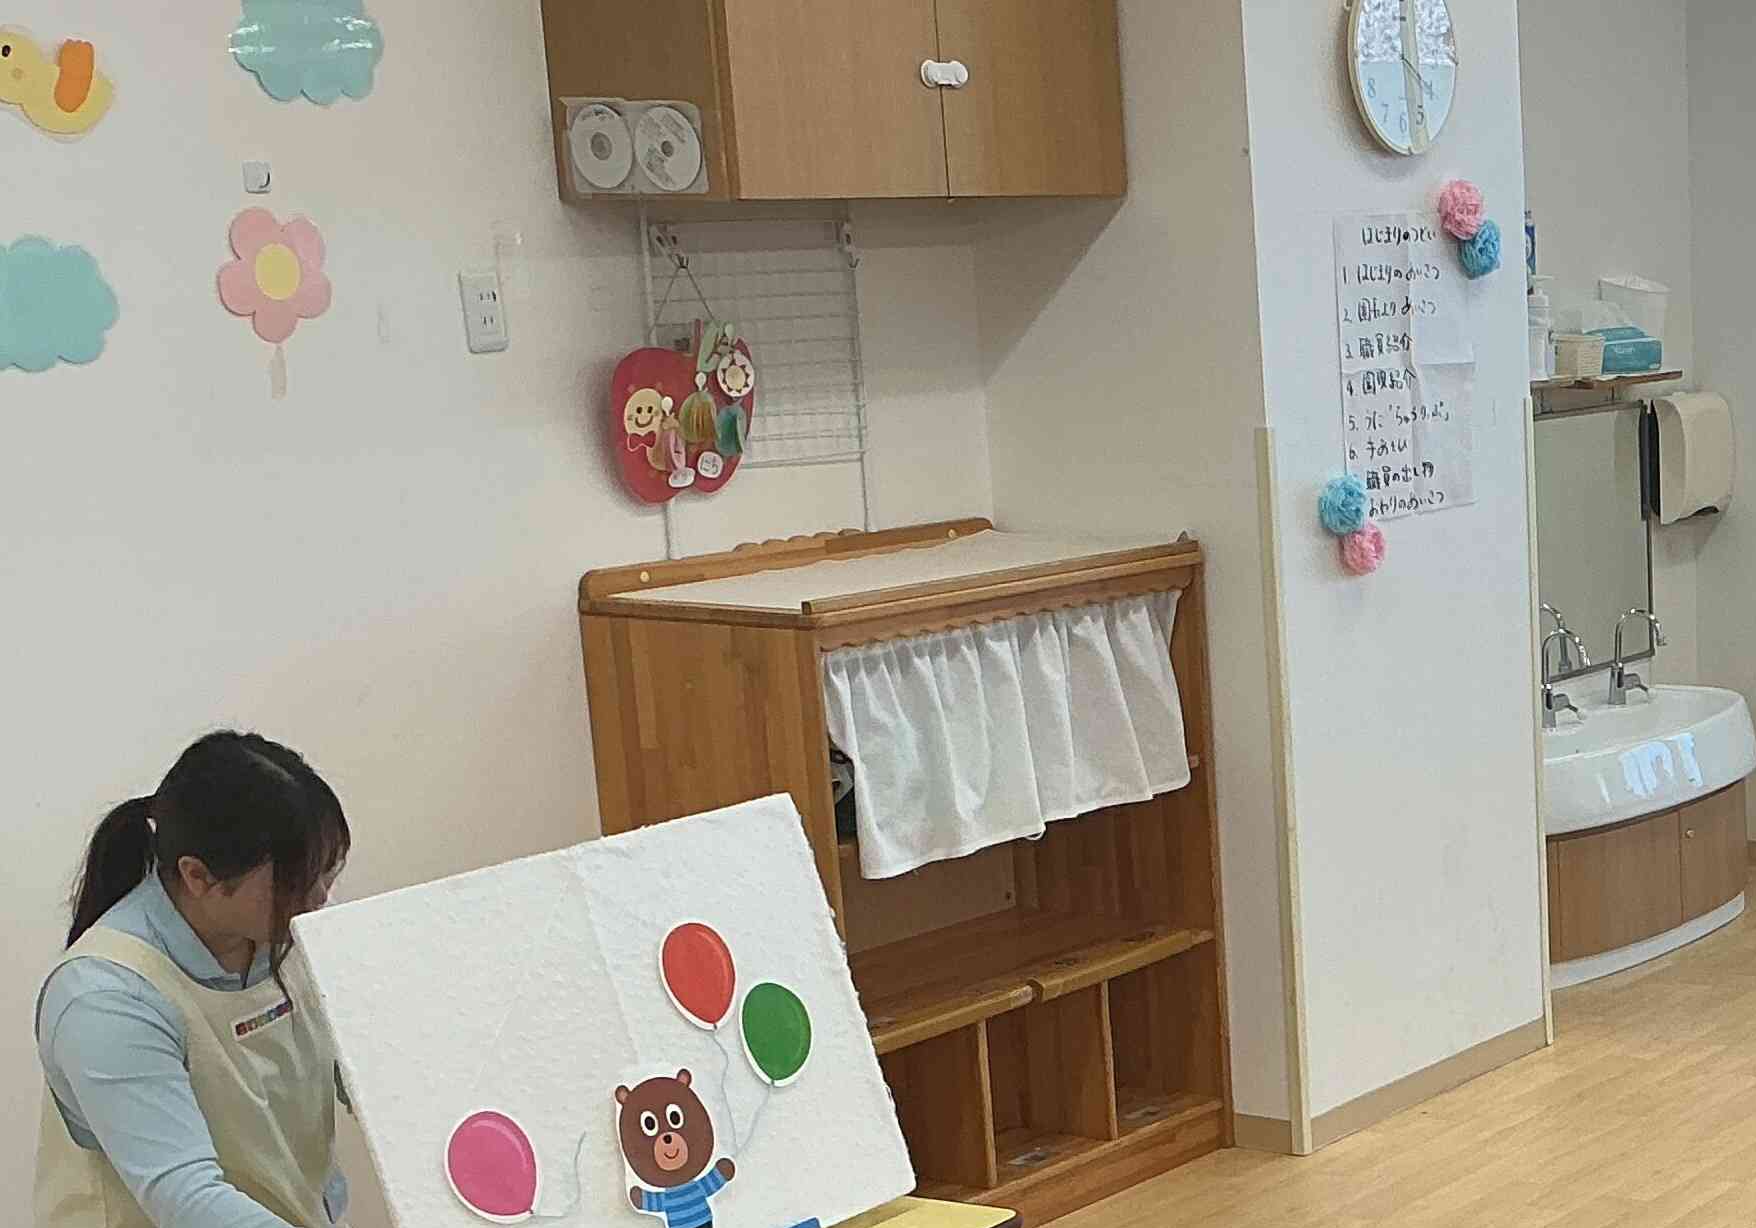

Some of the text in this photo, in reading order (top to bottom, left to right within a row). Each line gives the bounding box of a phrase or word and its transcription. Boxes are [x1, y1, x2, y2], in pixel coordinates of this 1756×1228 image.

[1367, 78, 1376, 98] 8
[1382, 102, 1389, 122] 7
[1400, 111, 1407, 133] 6
[1416, 104, 1424, 125] 5
